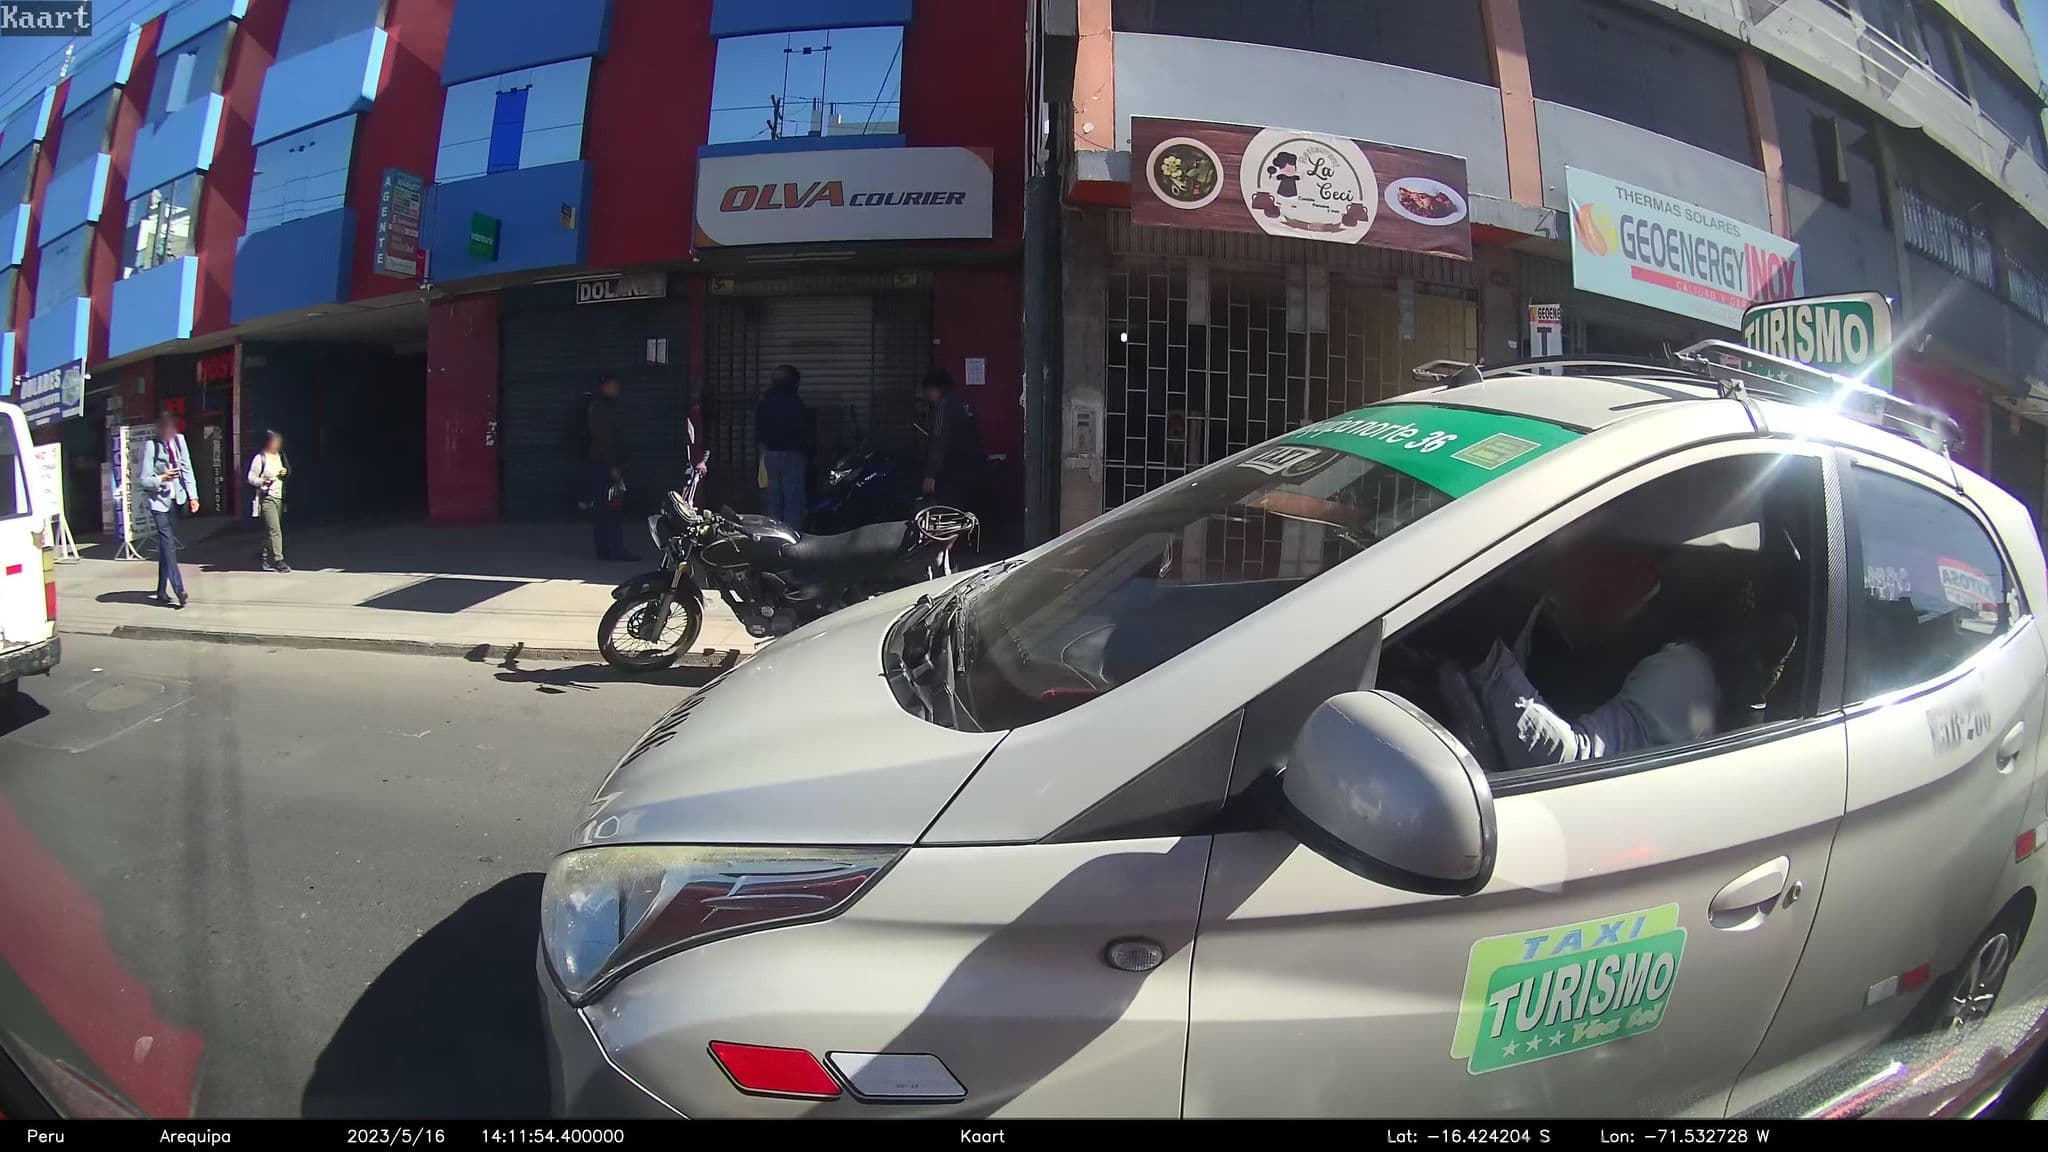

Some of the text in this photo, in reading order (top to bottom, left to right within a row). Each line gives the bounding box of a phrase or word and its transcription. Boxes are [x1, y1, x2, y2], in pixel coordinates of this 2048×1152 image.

[1307, 157, 1335, 180] La
[719, 180, 966, 213] OLVA COURIER
[1317, 182, 1354, 202] Ceci
[1615, 186, 1742, 239] THERMAS SOLARES
[376, 175, 391, 264] AGENTE
[1744, 304, 1868, 365] TURISMO
[1403, 430, 1458, 453] 36
[1522, 915, 1647, 960] TAXI
[1489, 952, 1675, 1038] TURISMO
